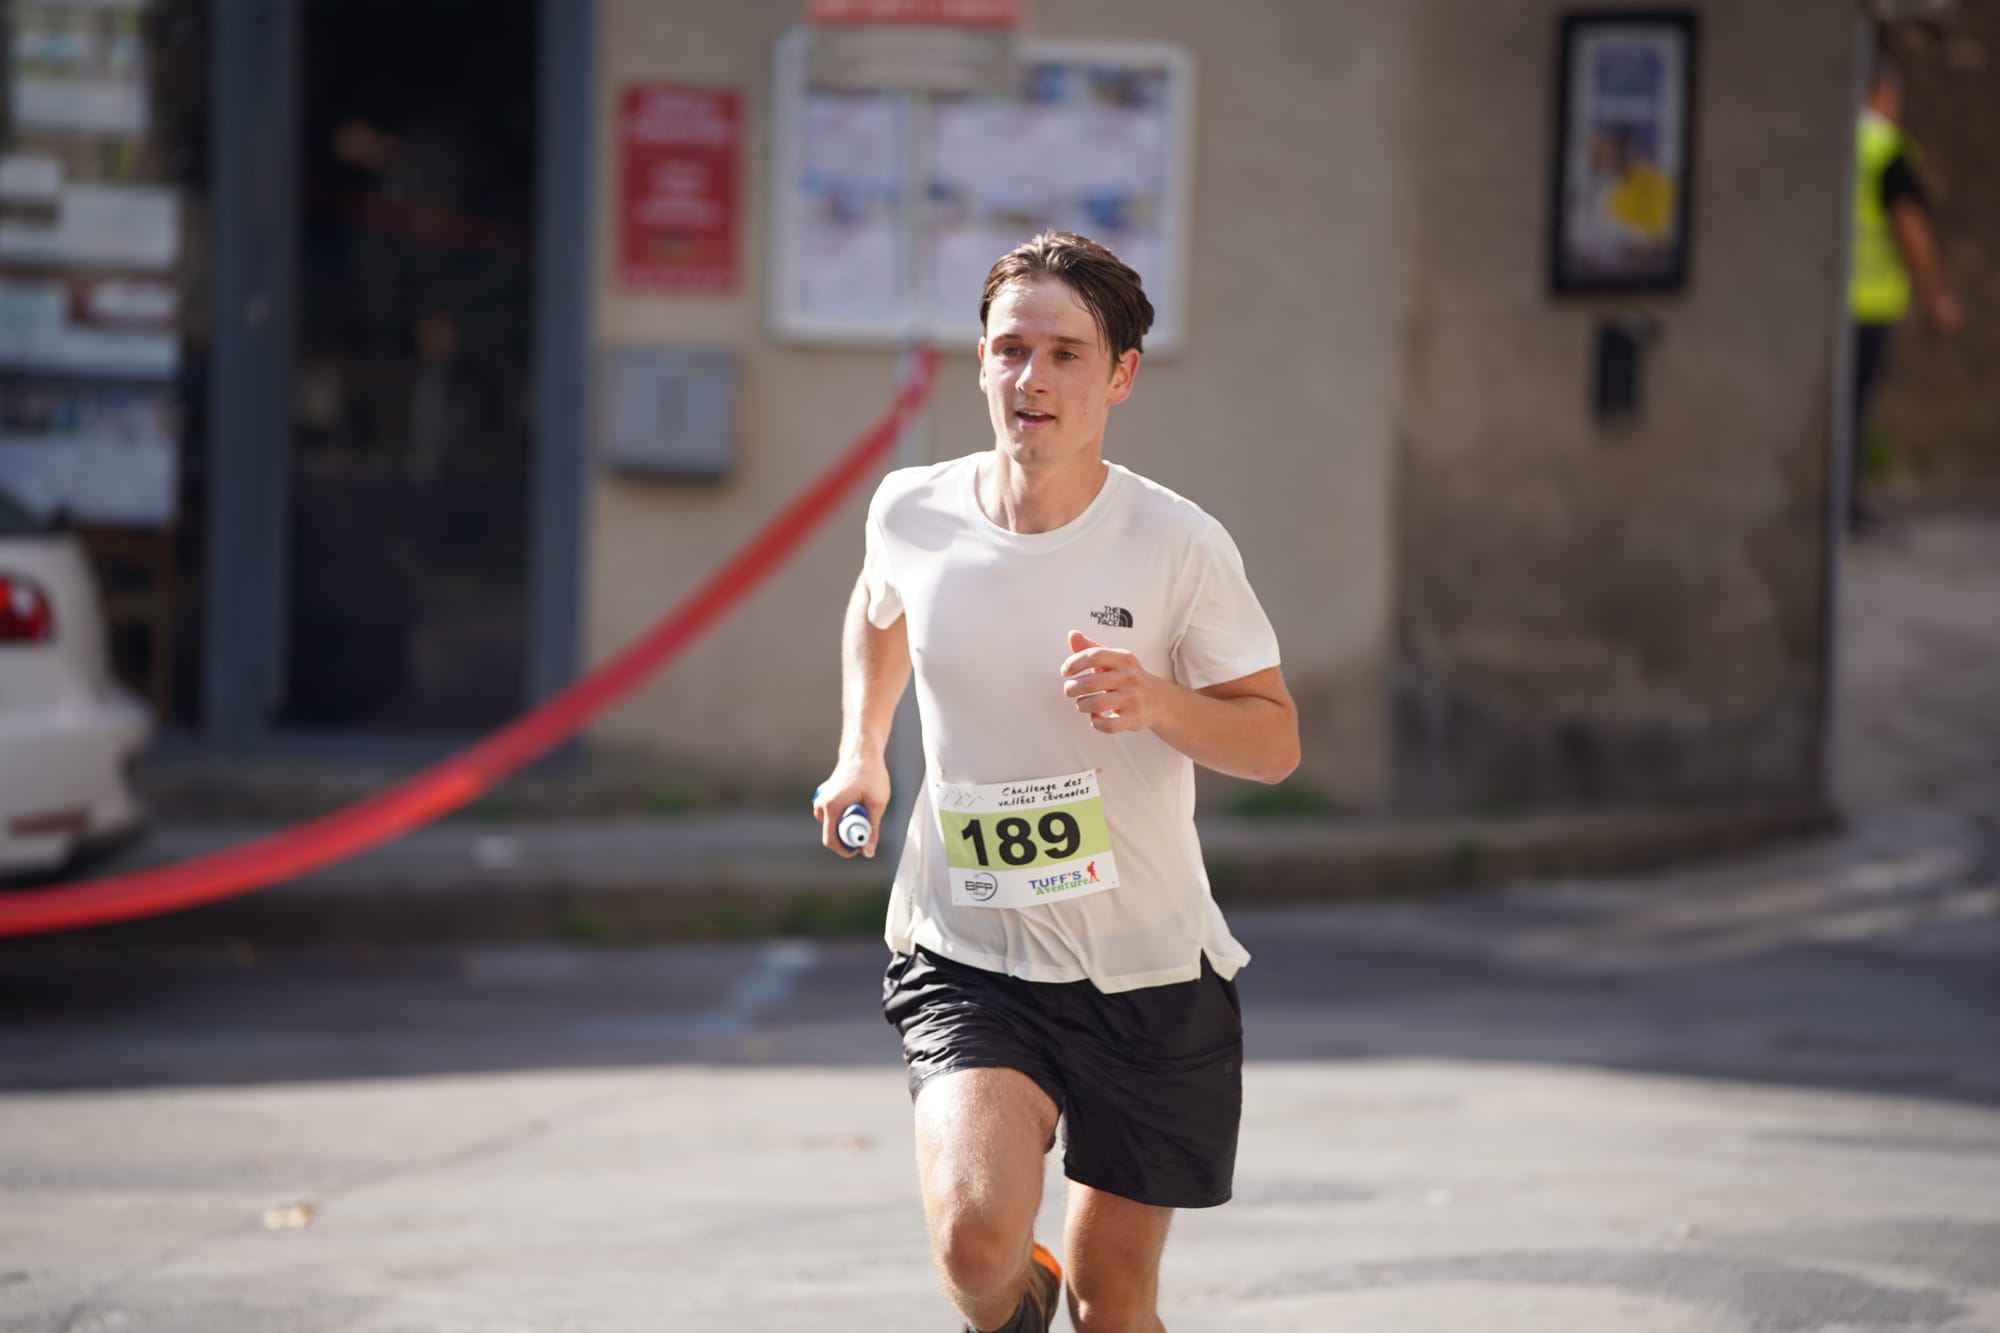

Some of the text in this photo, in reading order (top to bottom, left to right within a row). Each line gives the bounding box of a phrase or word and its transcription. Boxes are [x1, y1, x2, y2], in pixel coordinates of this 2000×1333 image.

[1090, 611, 1119, 621] NORTH
[1098, 617, 1119, 627] FACE
[1002, 777, 1082, 797] Challenge des
[998, 787, 1089, 807] vallées cévenoles
[961, 811, 1081, 866] 189
[1028, 870, 1082, 889] TUFF'S
[1036, 878, 1089, 896] Aventure
